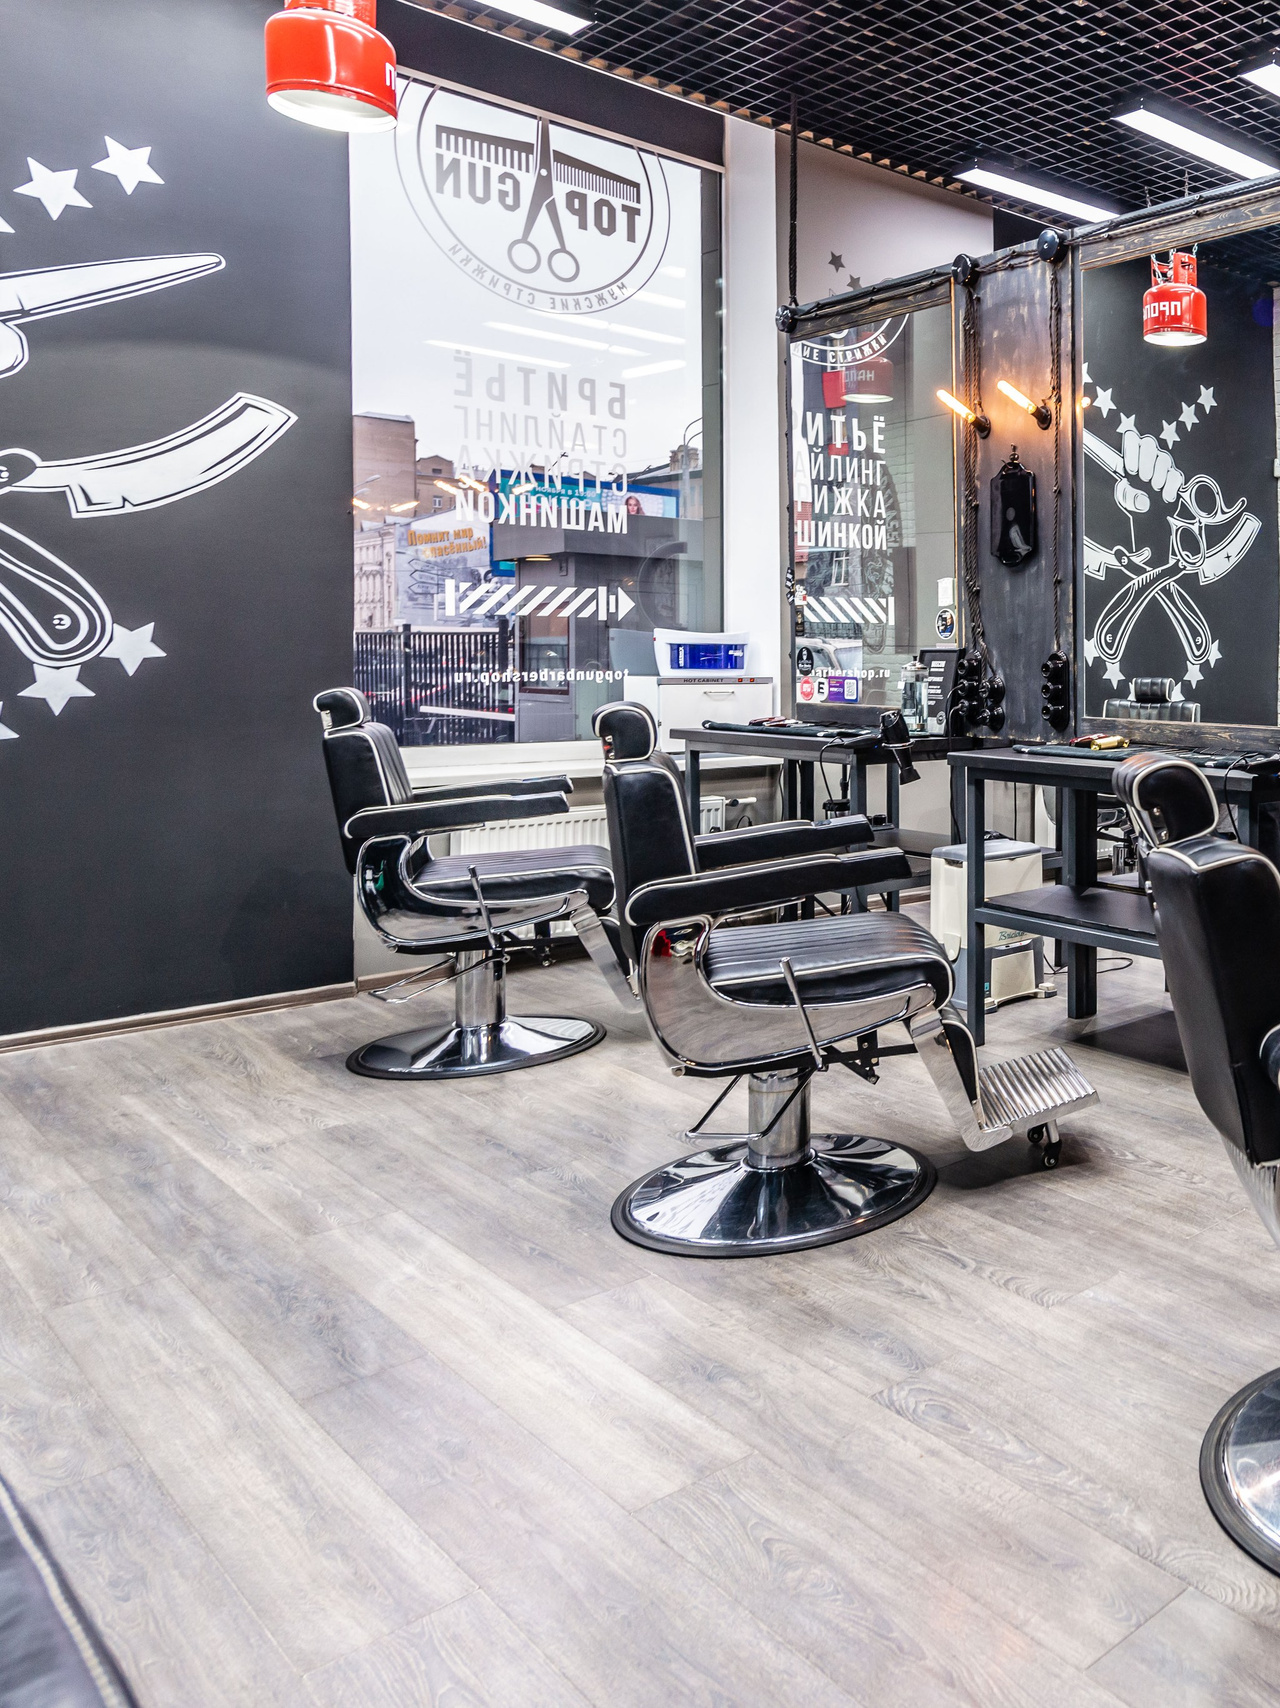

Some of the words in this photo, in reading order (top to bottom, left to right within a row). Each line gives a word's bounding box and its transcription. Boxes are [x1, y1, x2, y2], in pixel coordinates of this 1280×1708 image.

[829, 333, 888, 363] СТРИЖКИ
[408, 529, 450, 546] Помнит
[453, 527, 474, 541] мир
[797, 666, 891, 681] arbershop.ru
